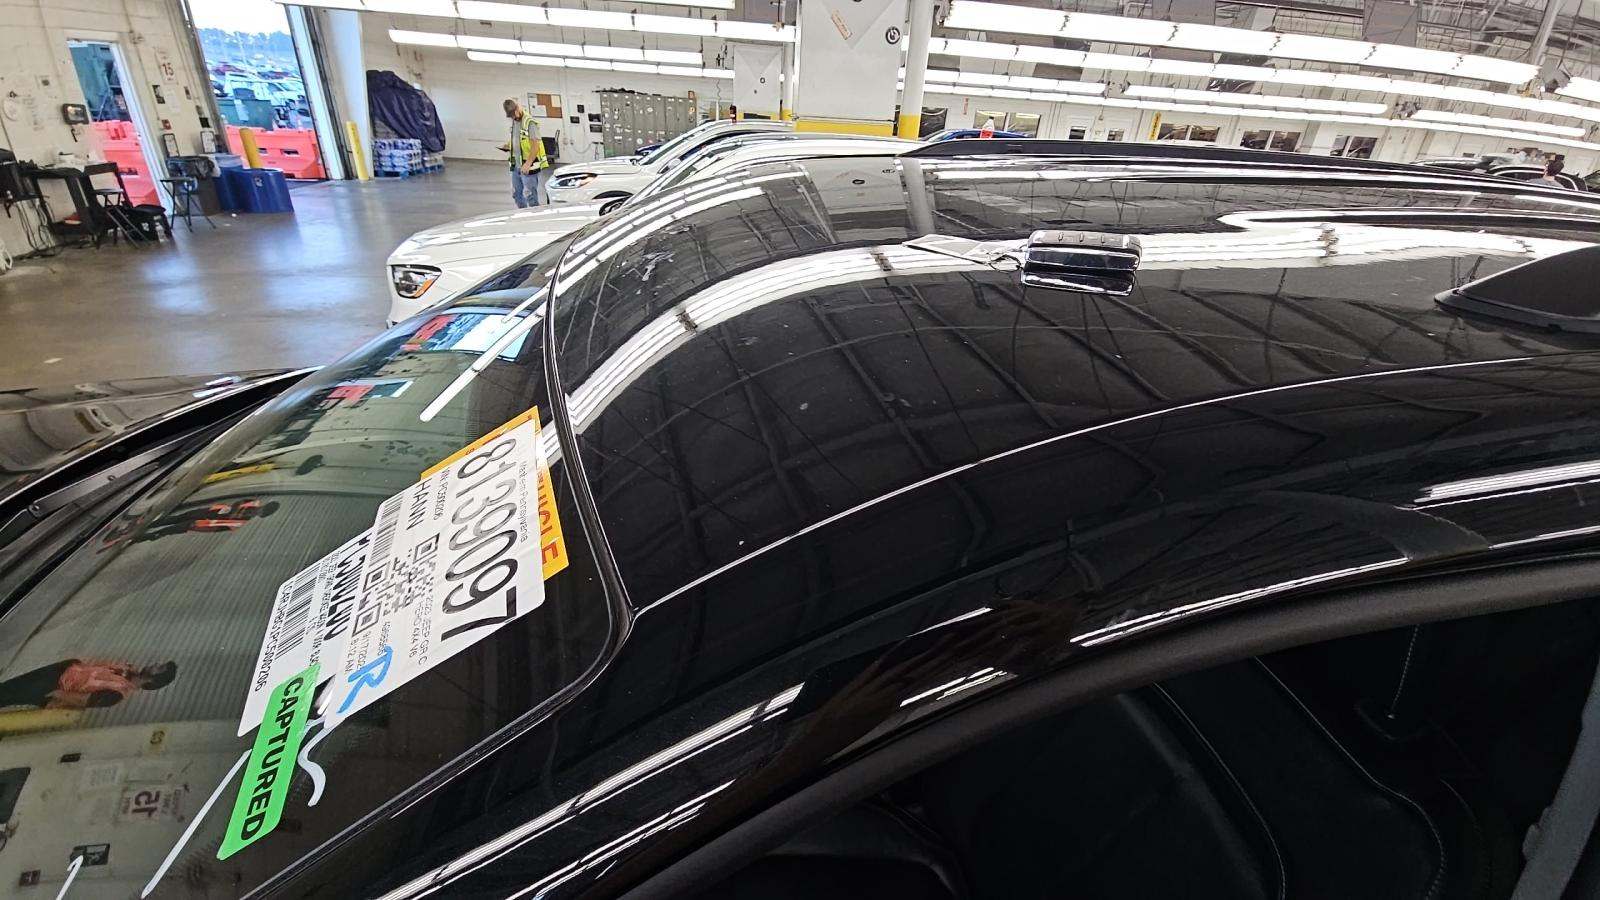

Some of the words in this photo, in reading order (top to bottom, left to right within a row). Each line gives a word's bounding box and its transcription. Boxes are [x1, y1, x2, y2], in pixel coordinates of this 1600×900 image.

[404, 478, 432, 532] HANN
[442, 438, 517, 642] 8139097
[241, 677, 304, 841] CAPTURED
